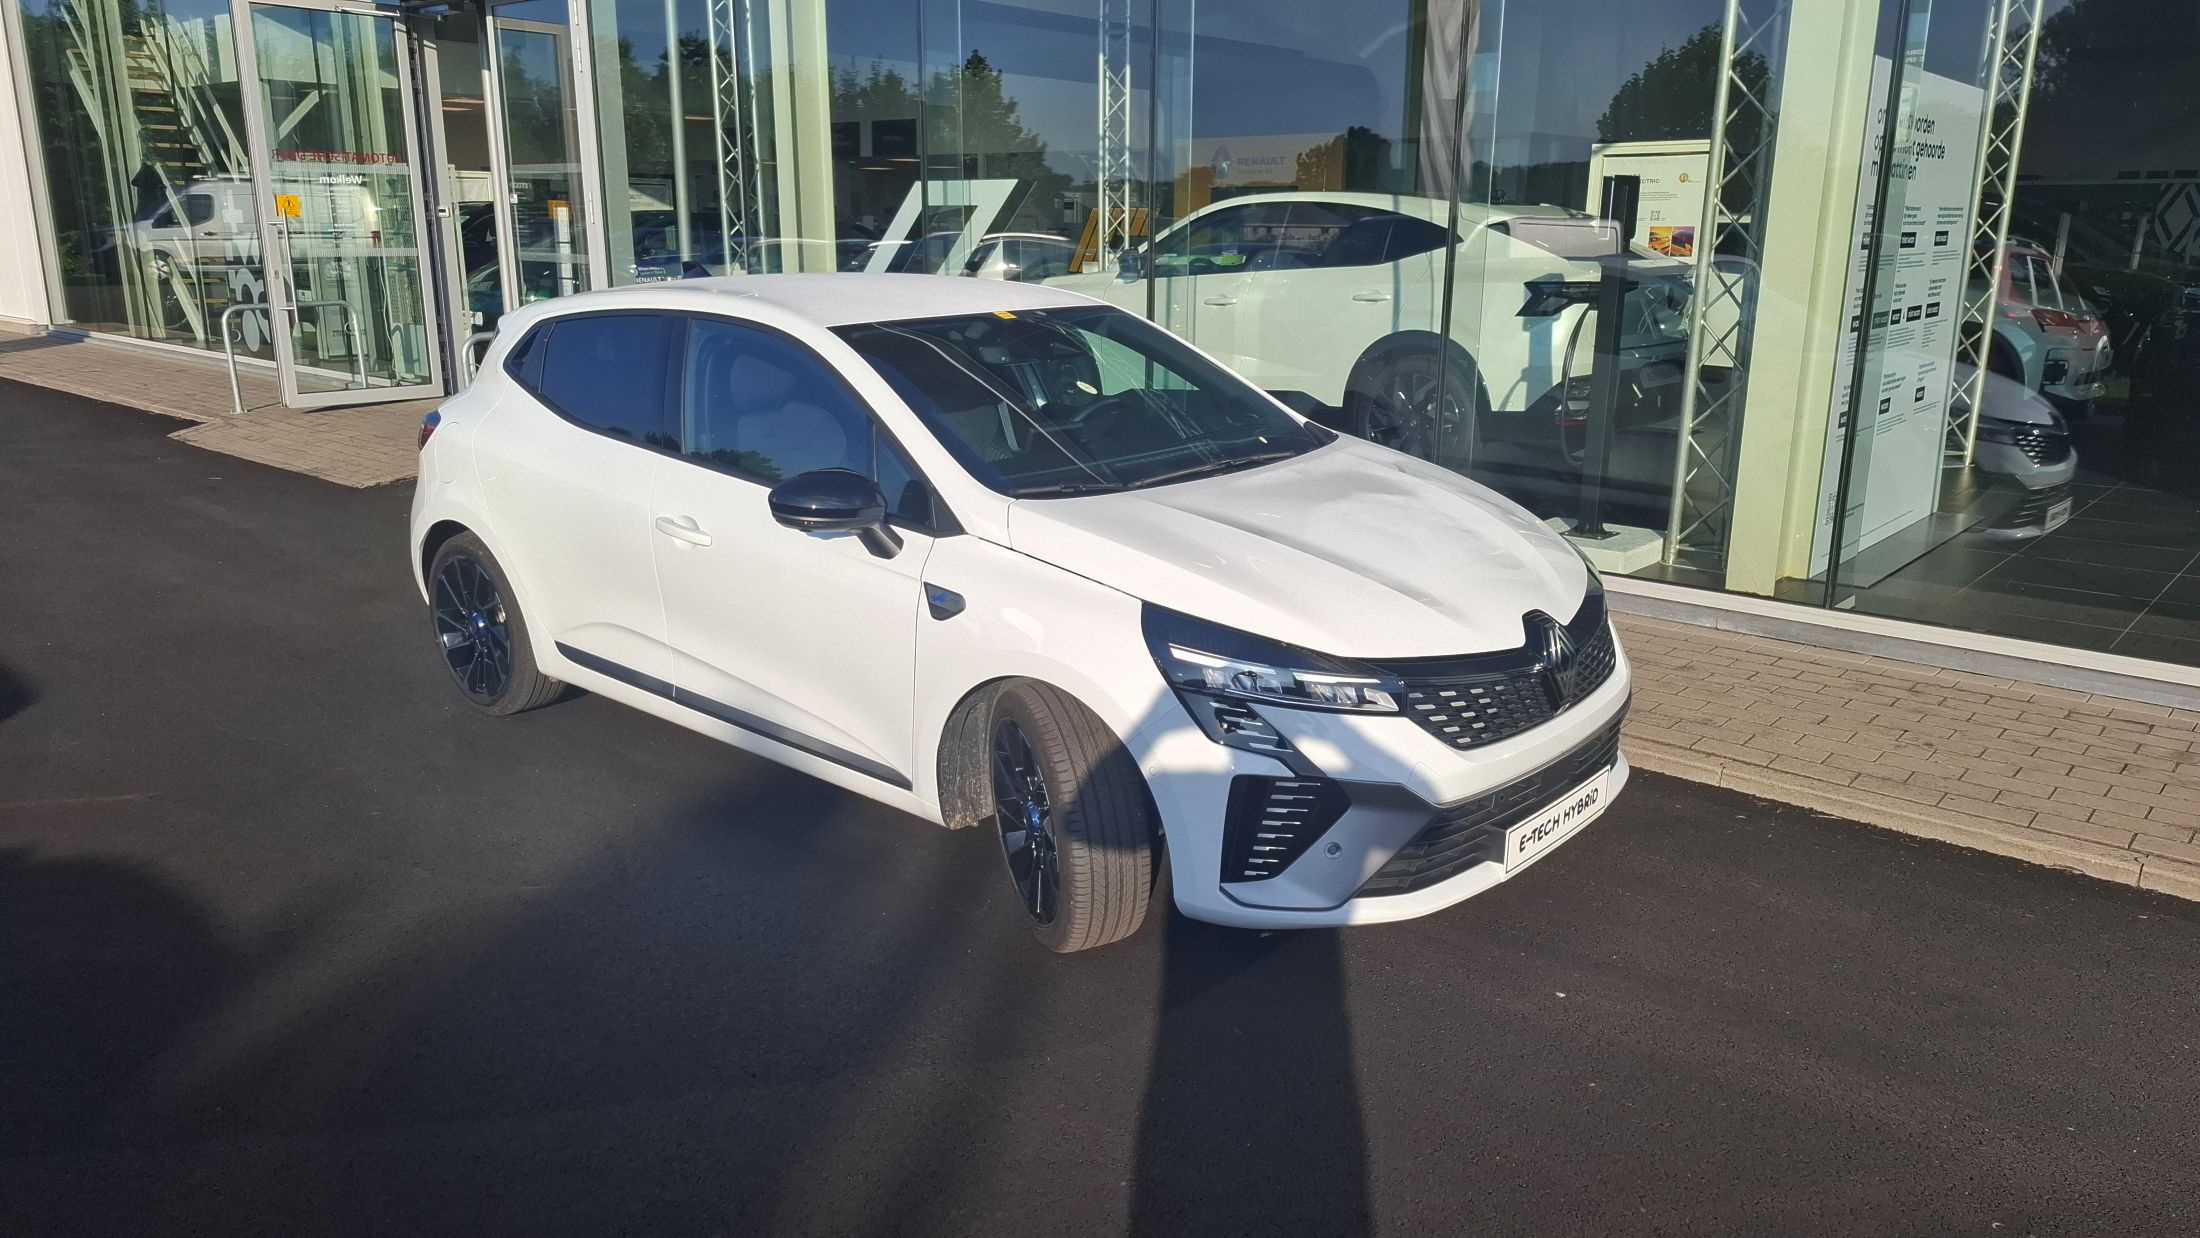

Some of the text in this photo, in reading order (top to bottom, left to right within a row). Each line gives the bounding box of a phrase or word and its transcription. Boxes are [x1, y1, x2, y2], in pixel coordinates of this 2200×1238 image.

[1237, 155, 1286, 167] RENAULT
[1916, 138, 1946, 162] gehoorde
[1519, 813, 1561, 854] E-TECH
